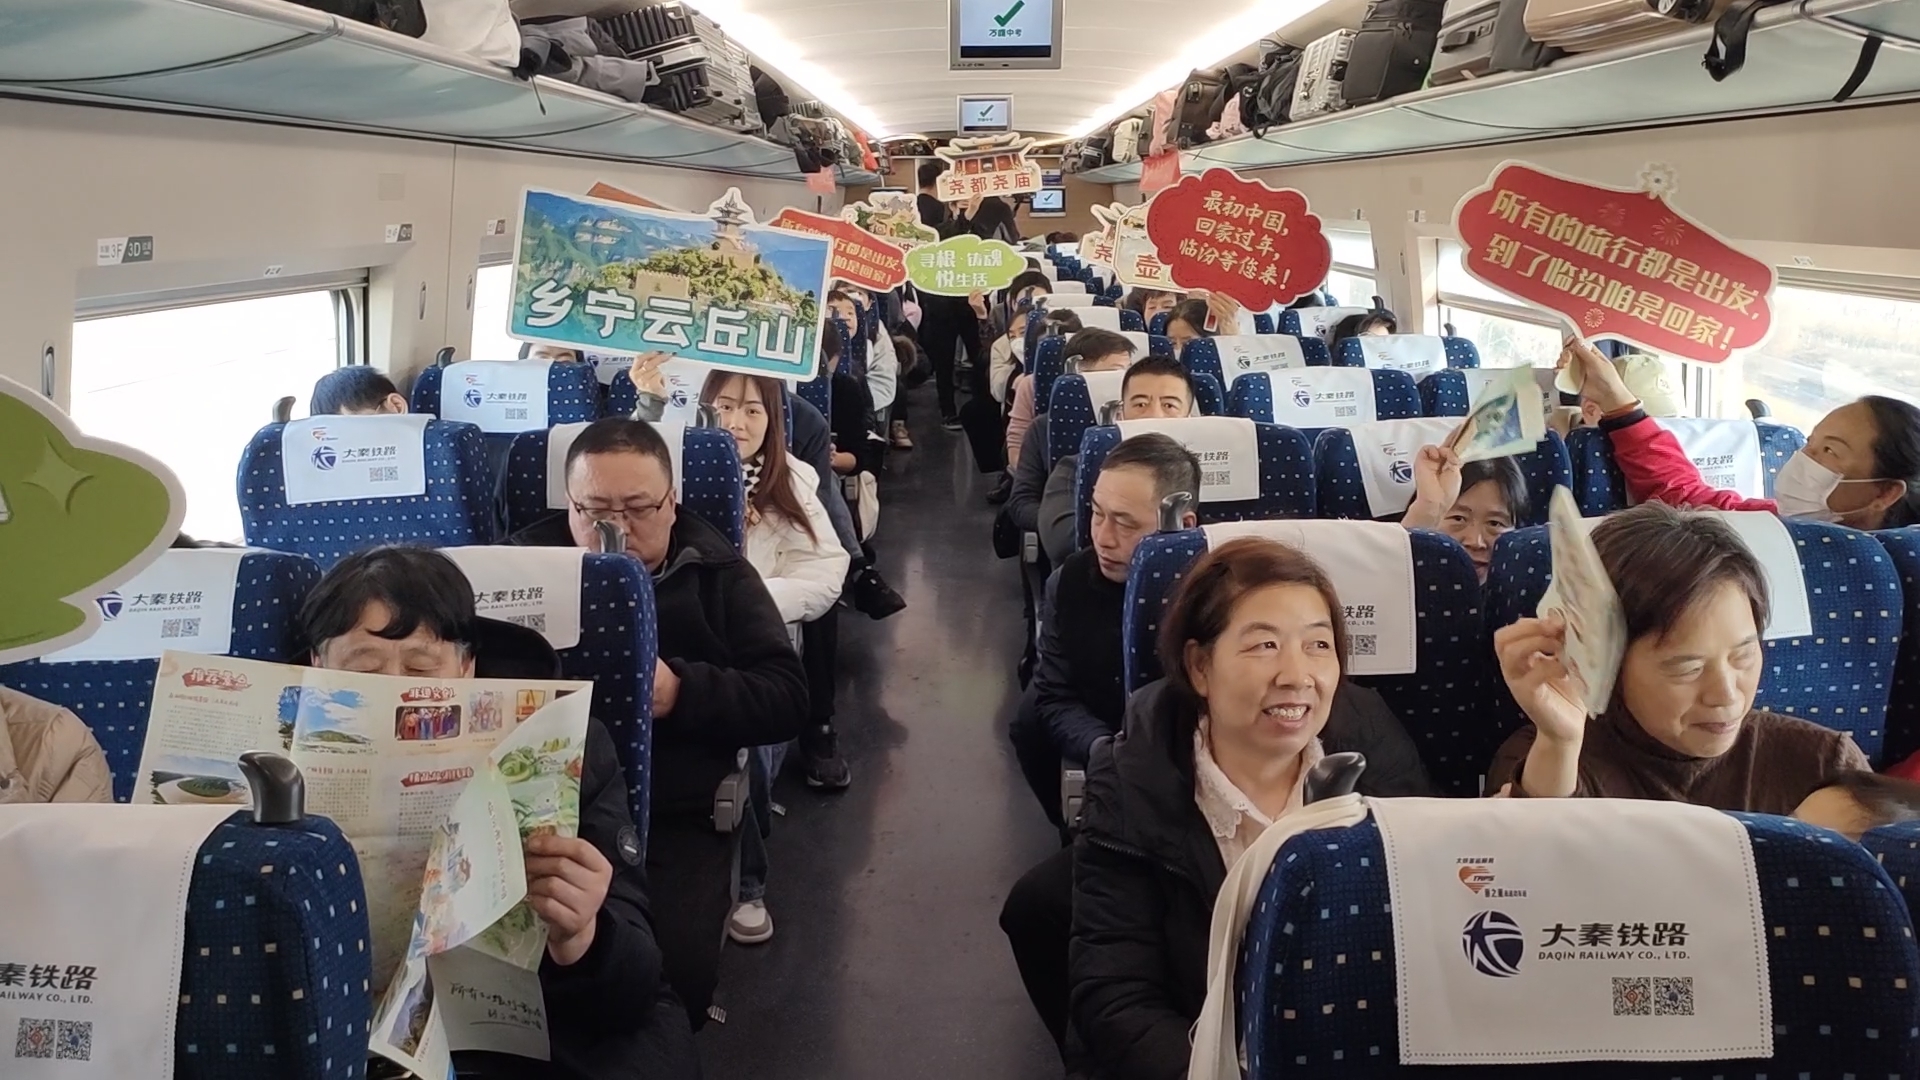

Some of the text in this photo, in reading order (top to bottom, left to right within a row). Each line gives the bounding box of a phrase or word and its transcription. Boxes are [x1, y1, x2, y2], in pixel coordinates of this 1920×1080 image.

[949, 172, 1031, 195] 尧都尧庙
[1203, 190, 1289, 236] 最初中国，
[128, 242, 141, 257] 3D
[1195, 217, 1282, 261] 回家过年，
[1178, 238, 1291, 290] 临汾等您来！
[1488, 189, 1760, 320] 所有的旅行都是出发，
[935, 271, 988, 288] 悦生活
[1482, 232, 1735, 351] 到了临汾咱是回家！
[526, 279, 806, 364] 乡宁云丘山
[343, 446, 397, 458] 大秦铁路
[130, 591, 204, 606] 大秦铁路
[474, 587, 545, 604] 大秦铁路
[1540, 922, 1690, 947] 大秦铁路
[1538, 950, 1690, 962] DAQIN RAILWAY CO., LTD.
[46, 993, 66, 1003] CO.,
[70, 995, 94, 1004] LTD.
